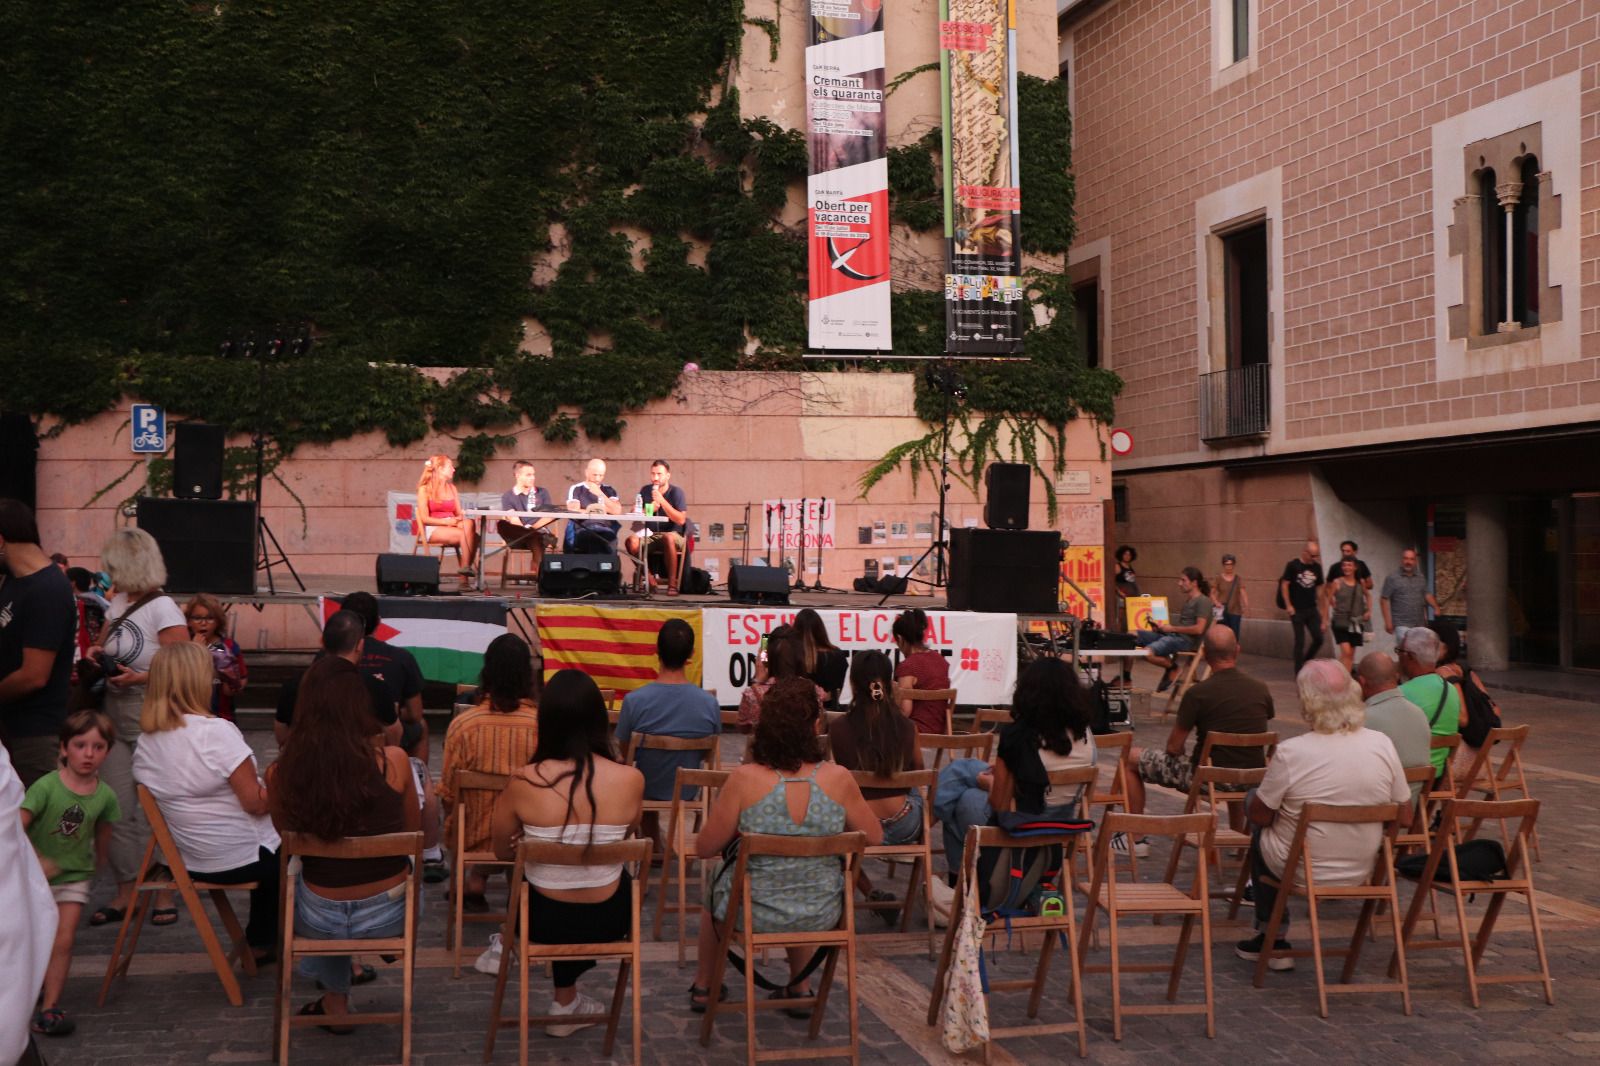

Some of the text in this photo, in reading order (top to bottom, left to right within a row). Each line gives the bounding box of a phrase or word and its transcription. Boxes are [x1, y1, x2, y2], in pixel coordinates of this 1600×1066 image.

[813, 75, 860, 88] Cremant
[813, 87, 882, 100] els quaranta
[815, 200, 868, 213] Obert per
[815, 213, 867, 223] vacances
[946, 276, 999, 290] CATALUNYA
[141, 408, 157, 429] P
[766, 502, 831, 520] MUSEU
[839, 612, 866, 642] EL
